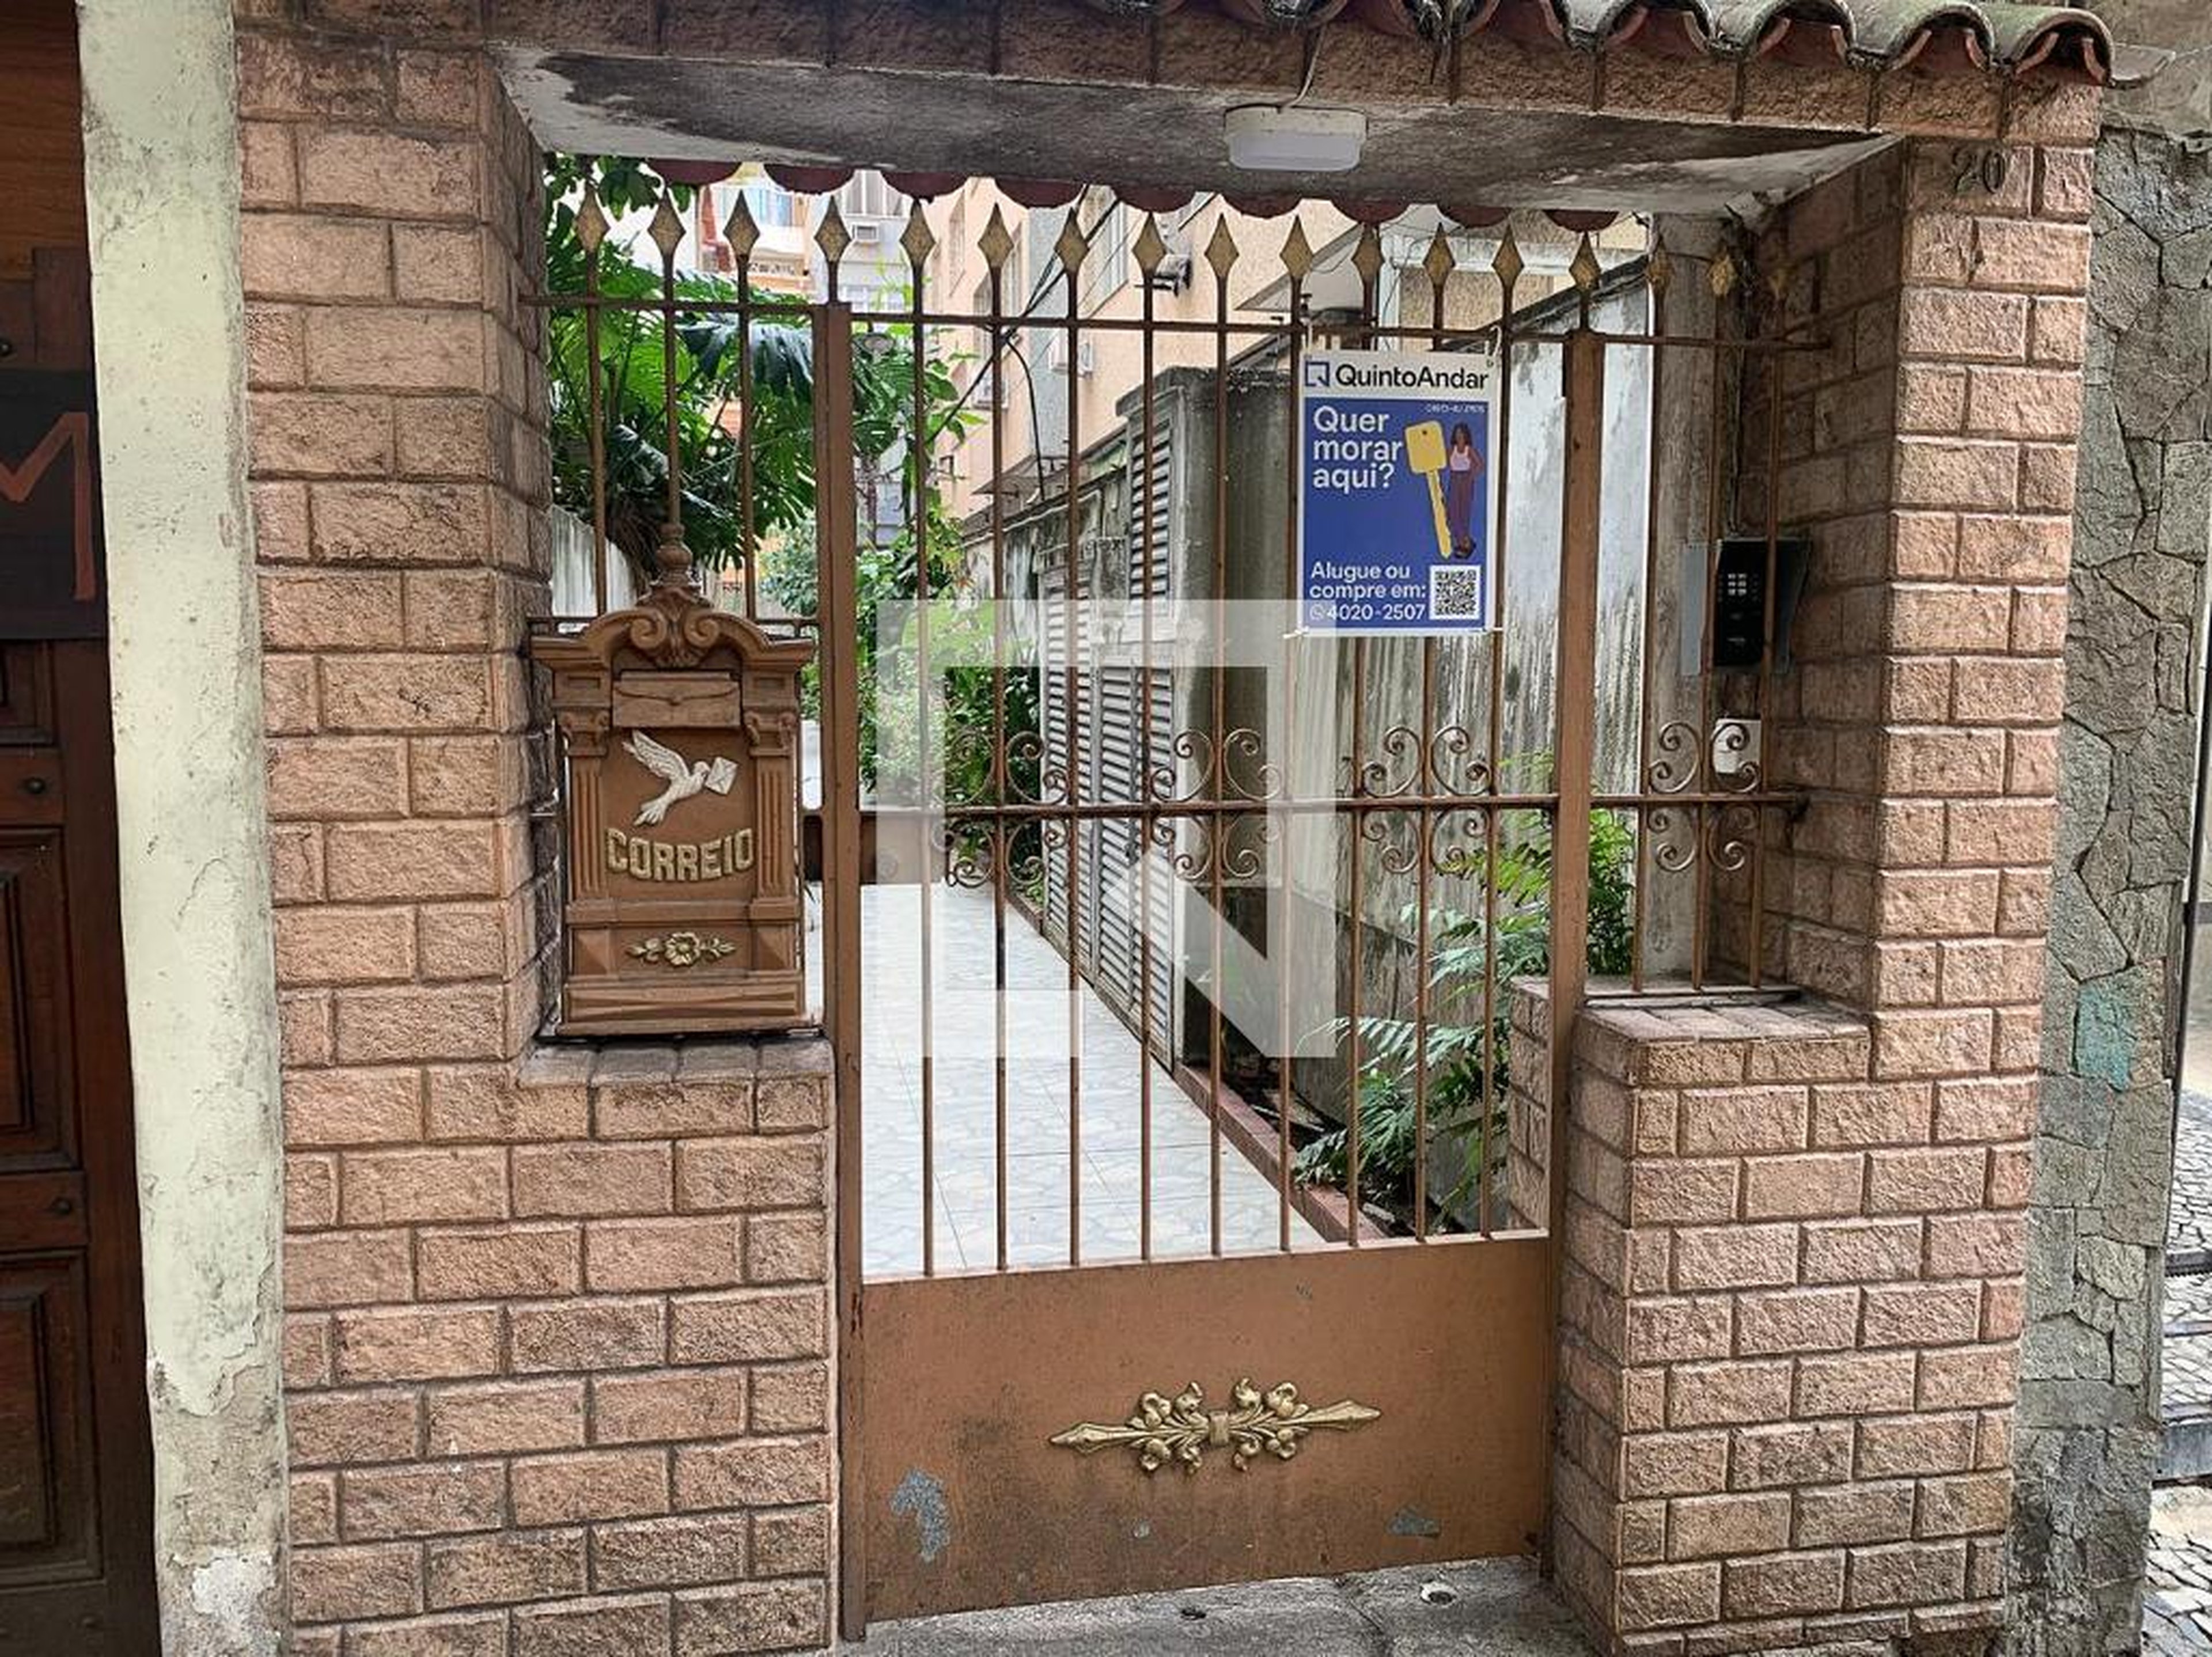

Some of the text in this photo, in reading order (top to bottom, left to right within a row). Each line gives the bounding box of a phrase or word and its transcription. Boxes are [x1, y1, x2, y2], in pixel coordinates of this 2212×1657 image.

[1952, 148, 2006, 195] 20
[1335, 363, 1489, 389] QuintoAndar
[1313, 405, 1389, 433] Quer
[1313, 439, 1402, 461] morar
[1312, 463, 1395, 494] aqui?
[1310, 562, 1410, 583] Alugue ou
[1309, 584, 1426, 601] compre em:
[607, 828, 754, 881] CORREIO
